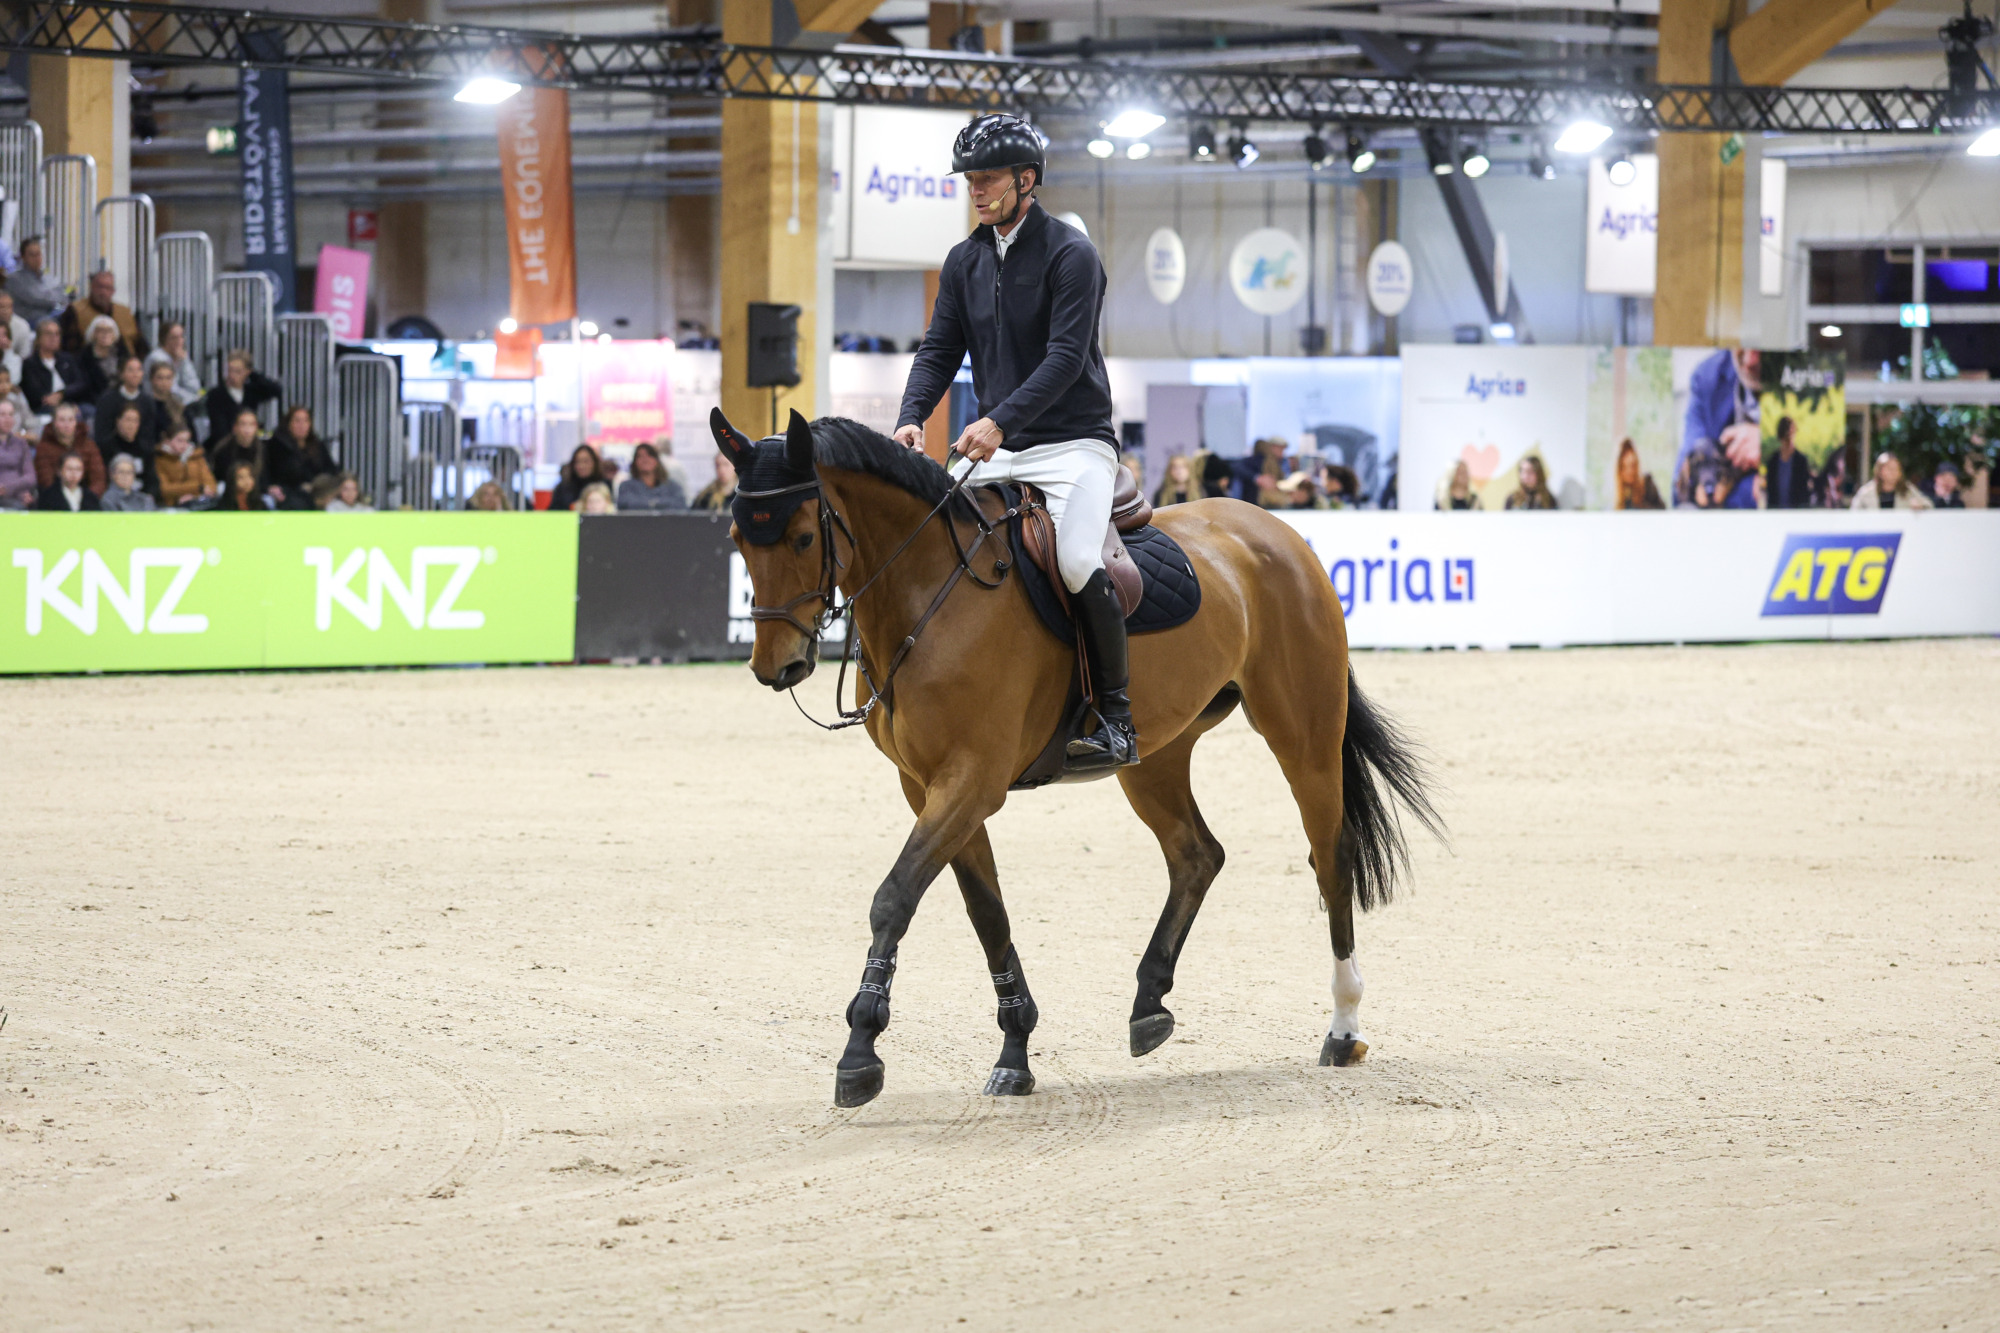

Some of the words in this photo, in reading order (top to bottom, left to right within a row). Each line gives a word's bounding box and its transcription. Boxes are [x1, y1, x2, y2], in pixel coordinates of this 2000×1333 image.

[866, 165, 936, 203] Agria
[1466, 372, 1512, 401] Agria
[1781, 365, 1823, 392] Agria
[12, 547, 209, 636] KNZ
[304, 546, 486, 631] KNZ
[1326, 539, 1434, 618] gria
[1769, 546, 1887, 601] ATG
